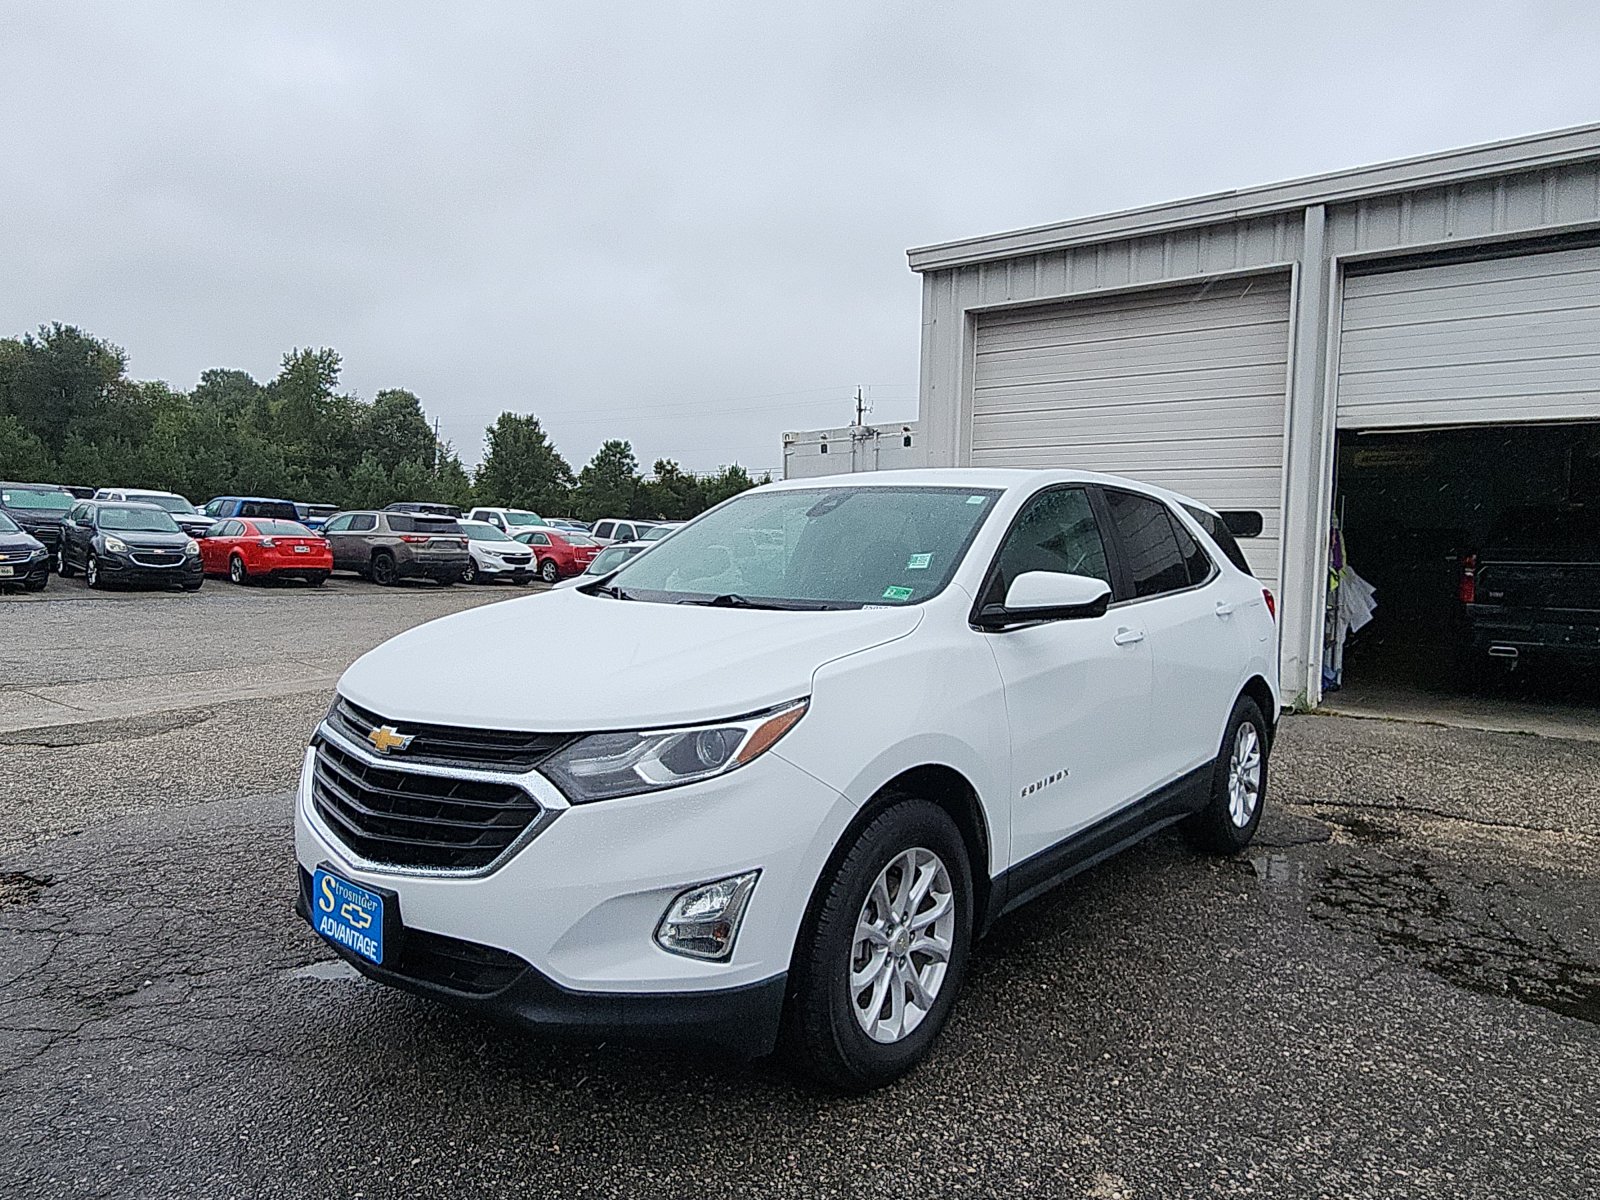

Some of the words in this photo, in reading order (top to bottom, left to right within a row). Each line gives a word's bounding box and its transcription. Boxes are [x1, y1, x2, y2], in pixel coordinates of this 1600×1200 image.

[1022, 768, 1070, 798] EQUINOX
[319, 875, 378, 912] Strosnider
[320, 916, 378, 960] ADVANTAGE
